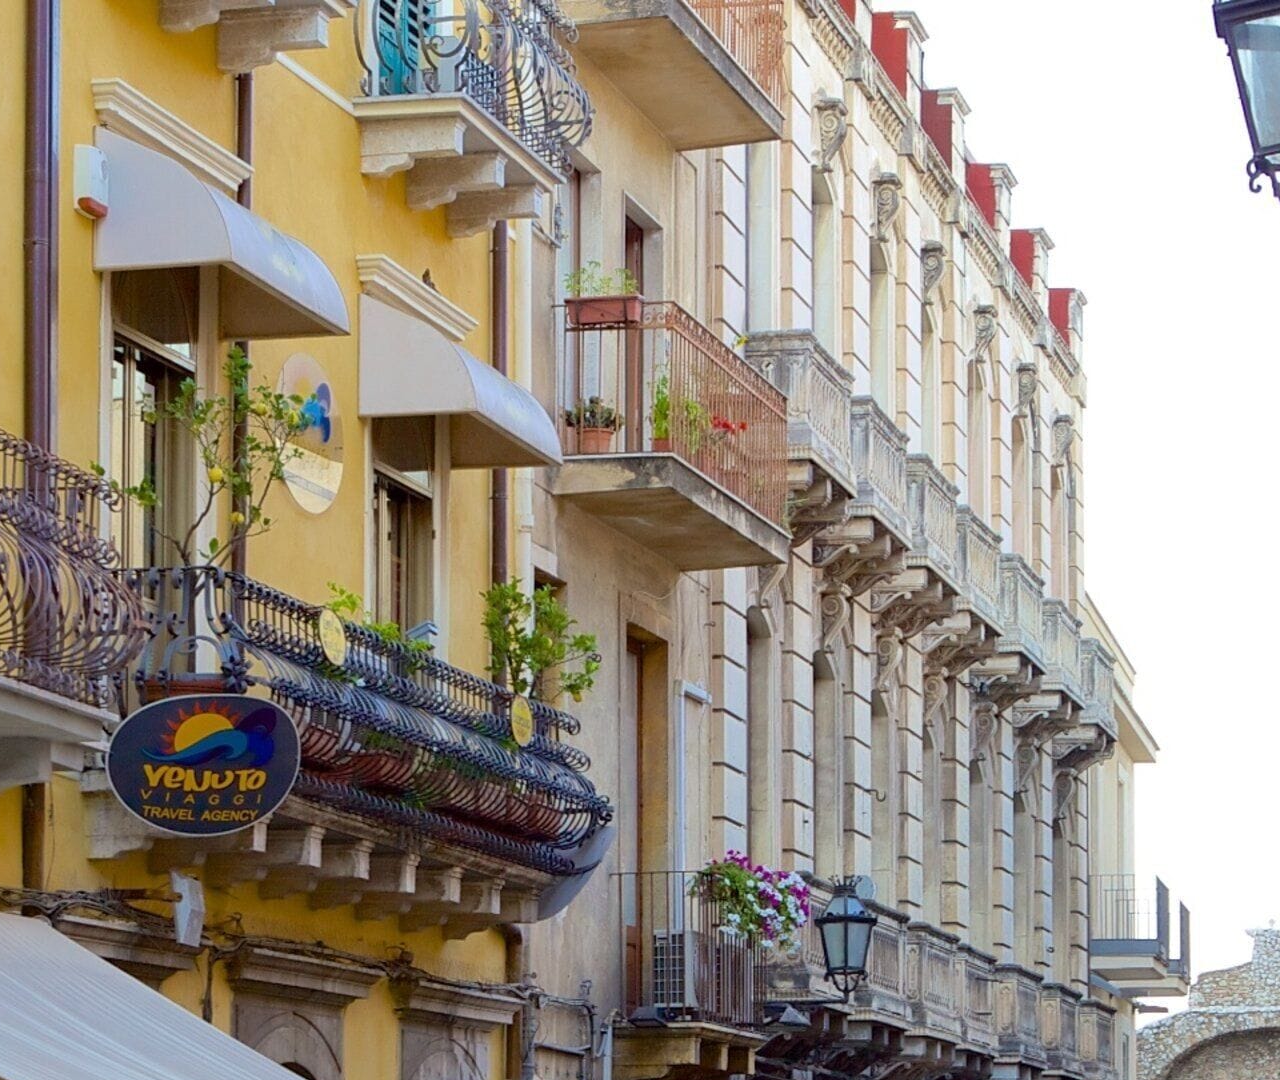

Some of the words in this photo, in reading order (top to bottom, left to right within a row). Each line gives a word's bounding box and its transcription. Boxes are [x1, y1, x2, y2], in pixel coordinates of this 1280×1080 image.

[141, 789, 262, 806] VIAGGI
[143, 805, 195, 821] TRAVEL
[200, 809, 259, 822] AGENCY
